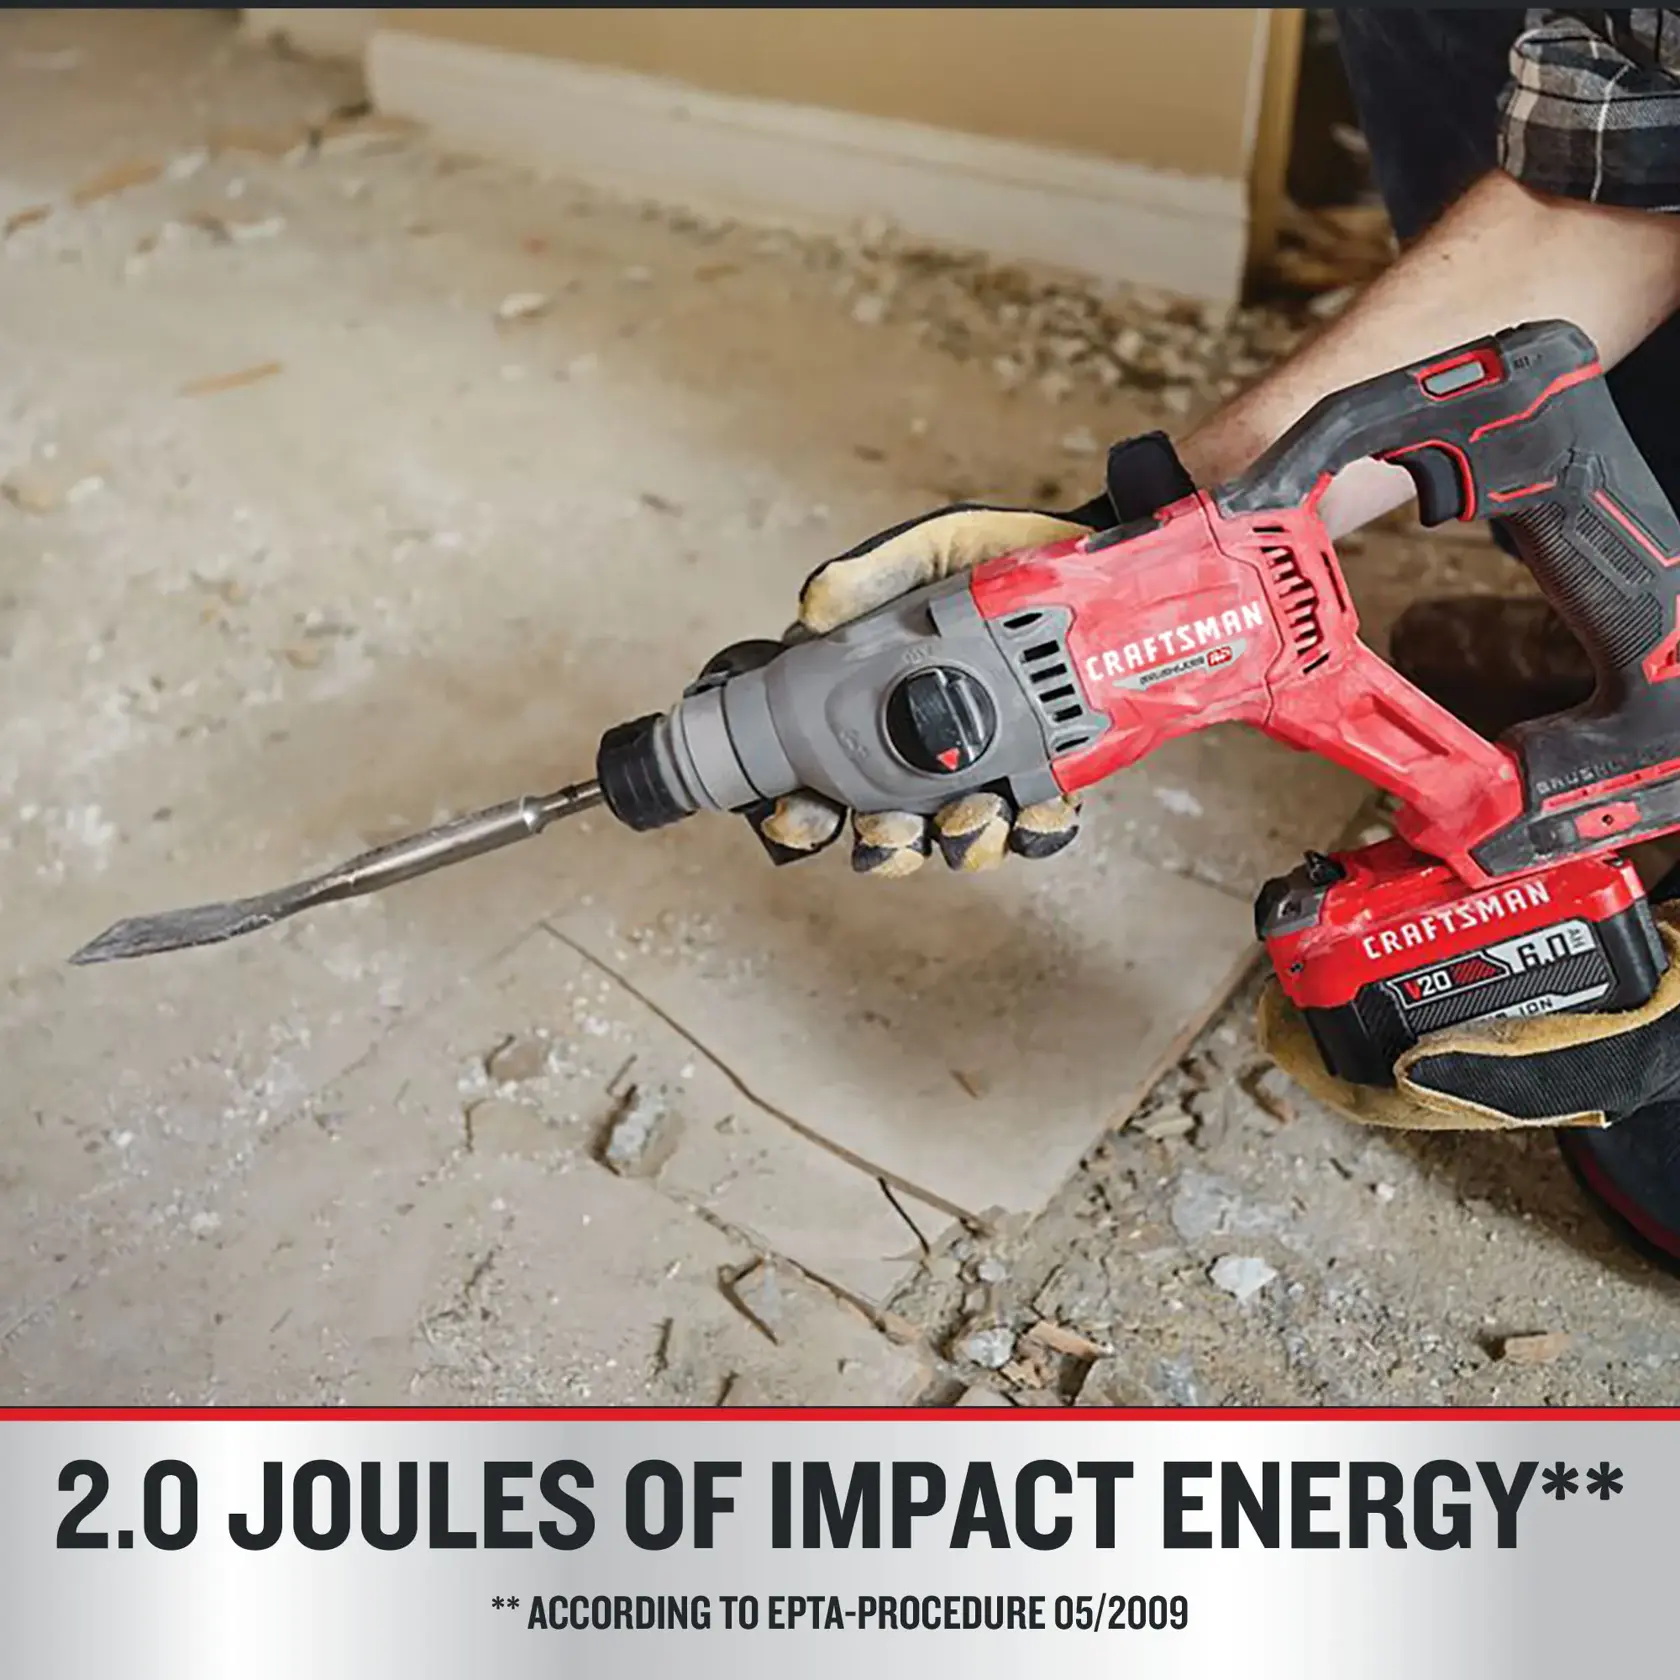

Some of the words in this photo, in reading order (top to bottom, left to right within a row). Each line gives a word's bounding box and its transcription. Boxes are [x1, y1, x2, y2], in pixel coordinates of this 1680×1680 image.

[1085, 601, 1264, 682] CRAFTSMAN
[1363, 881, 1551, 960] CRAFTSMAN
[1516, 932, 1571, 969] 6.0
[1403, 970, 1453, 1001] V20
